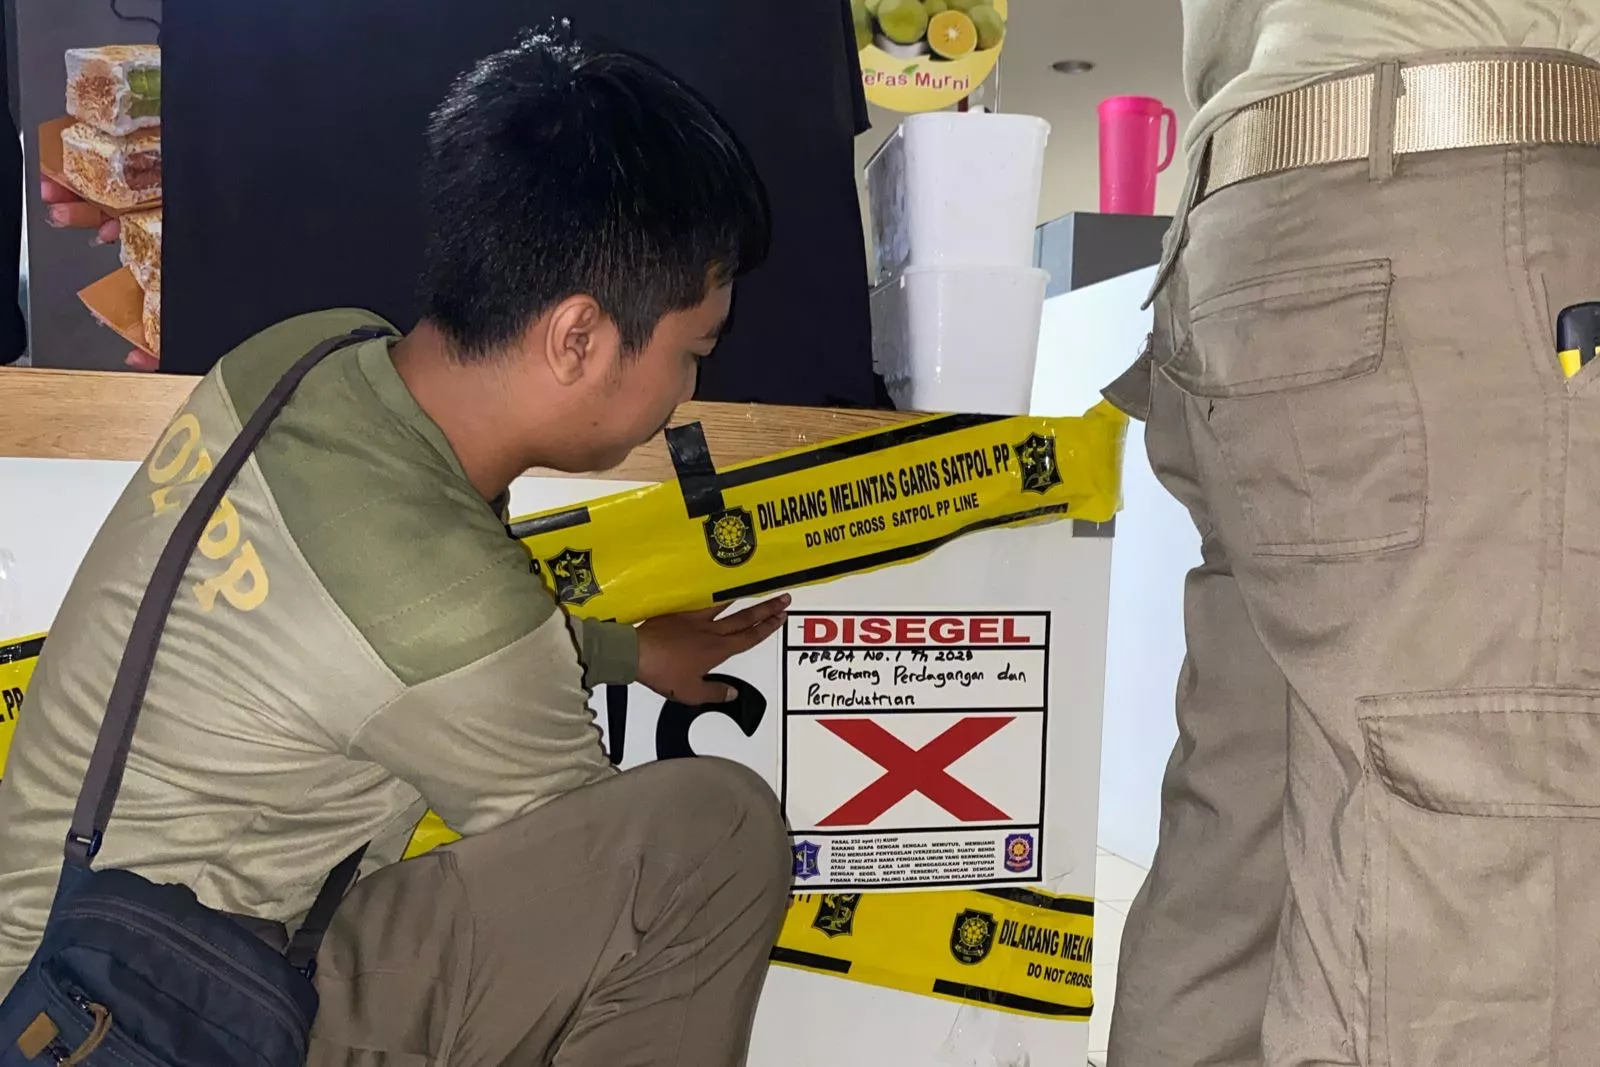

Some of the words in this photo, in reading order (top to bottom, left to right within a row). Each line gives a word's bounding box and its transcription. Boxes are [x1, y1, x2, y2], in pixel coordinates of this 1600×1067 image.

[915, 72, 969, 91] Murni
[757, 489, 828, 531] DILARANG
[828, 471, 898, 514] MELINTAS
[898, 460, 940, 498] GARIS
[941, 450, 993, 487] SATPOL
[993, 442, 1011, 474] PP
[804, 529, 822, 549] DO
[823, 523, 848, 543] NOT
[849, 516, 886, 538] CROSS
[892, 504, 935, 528] SATPOL
[936, 501, 951, 516] PP
[952, 492, 980, 511] LINE
[803, 618, 1031, 644] DISEGEL
[816, 665, 881, 685] Tentang
[893, 665, 985, 686] Perdagangan
[997, 662, 1027, 683] dan
[807, 683, 916, 706] Perindustrian
[998, 919, 1060, 956] DILARANG
[1027, 962, 1042, 978] DO
[1044, 966, 1065, 983] NOT
[1065, 971, 1093, 989] CROSS
